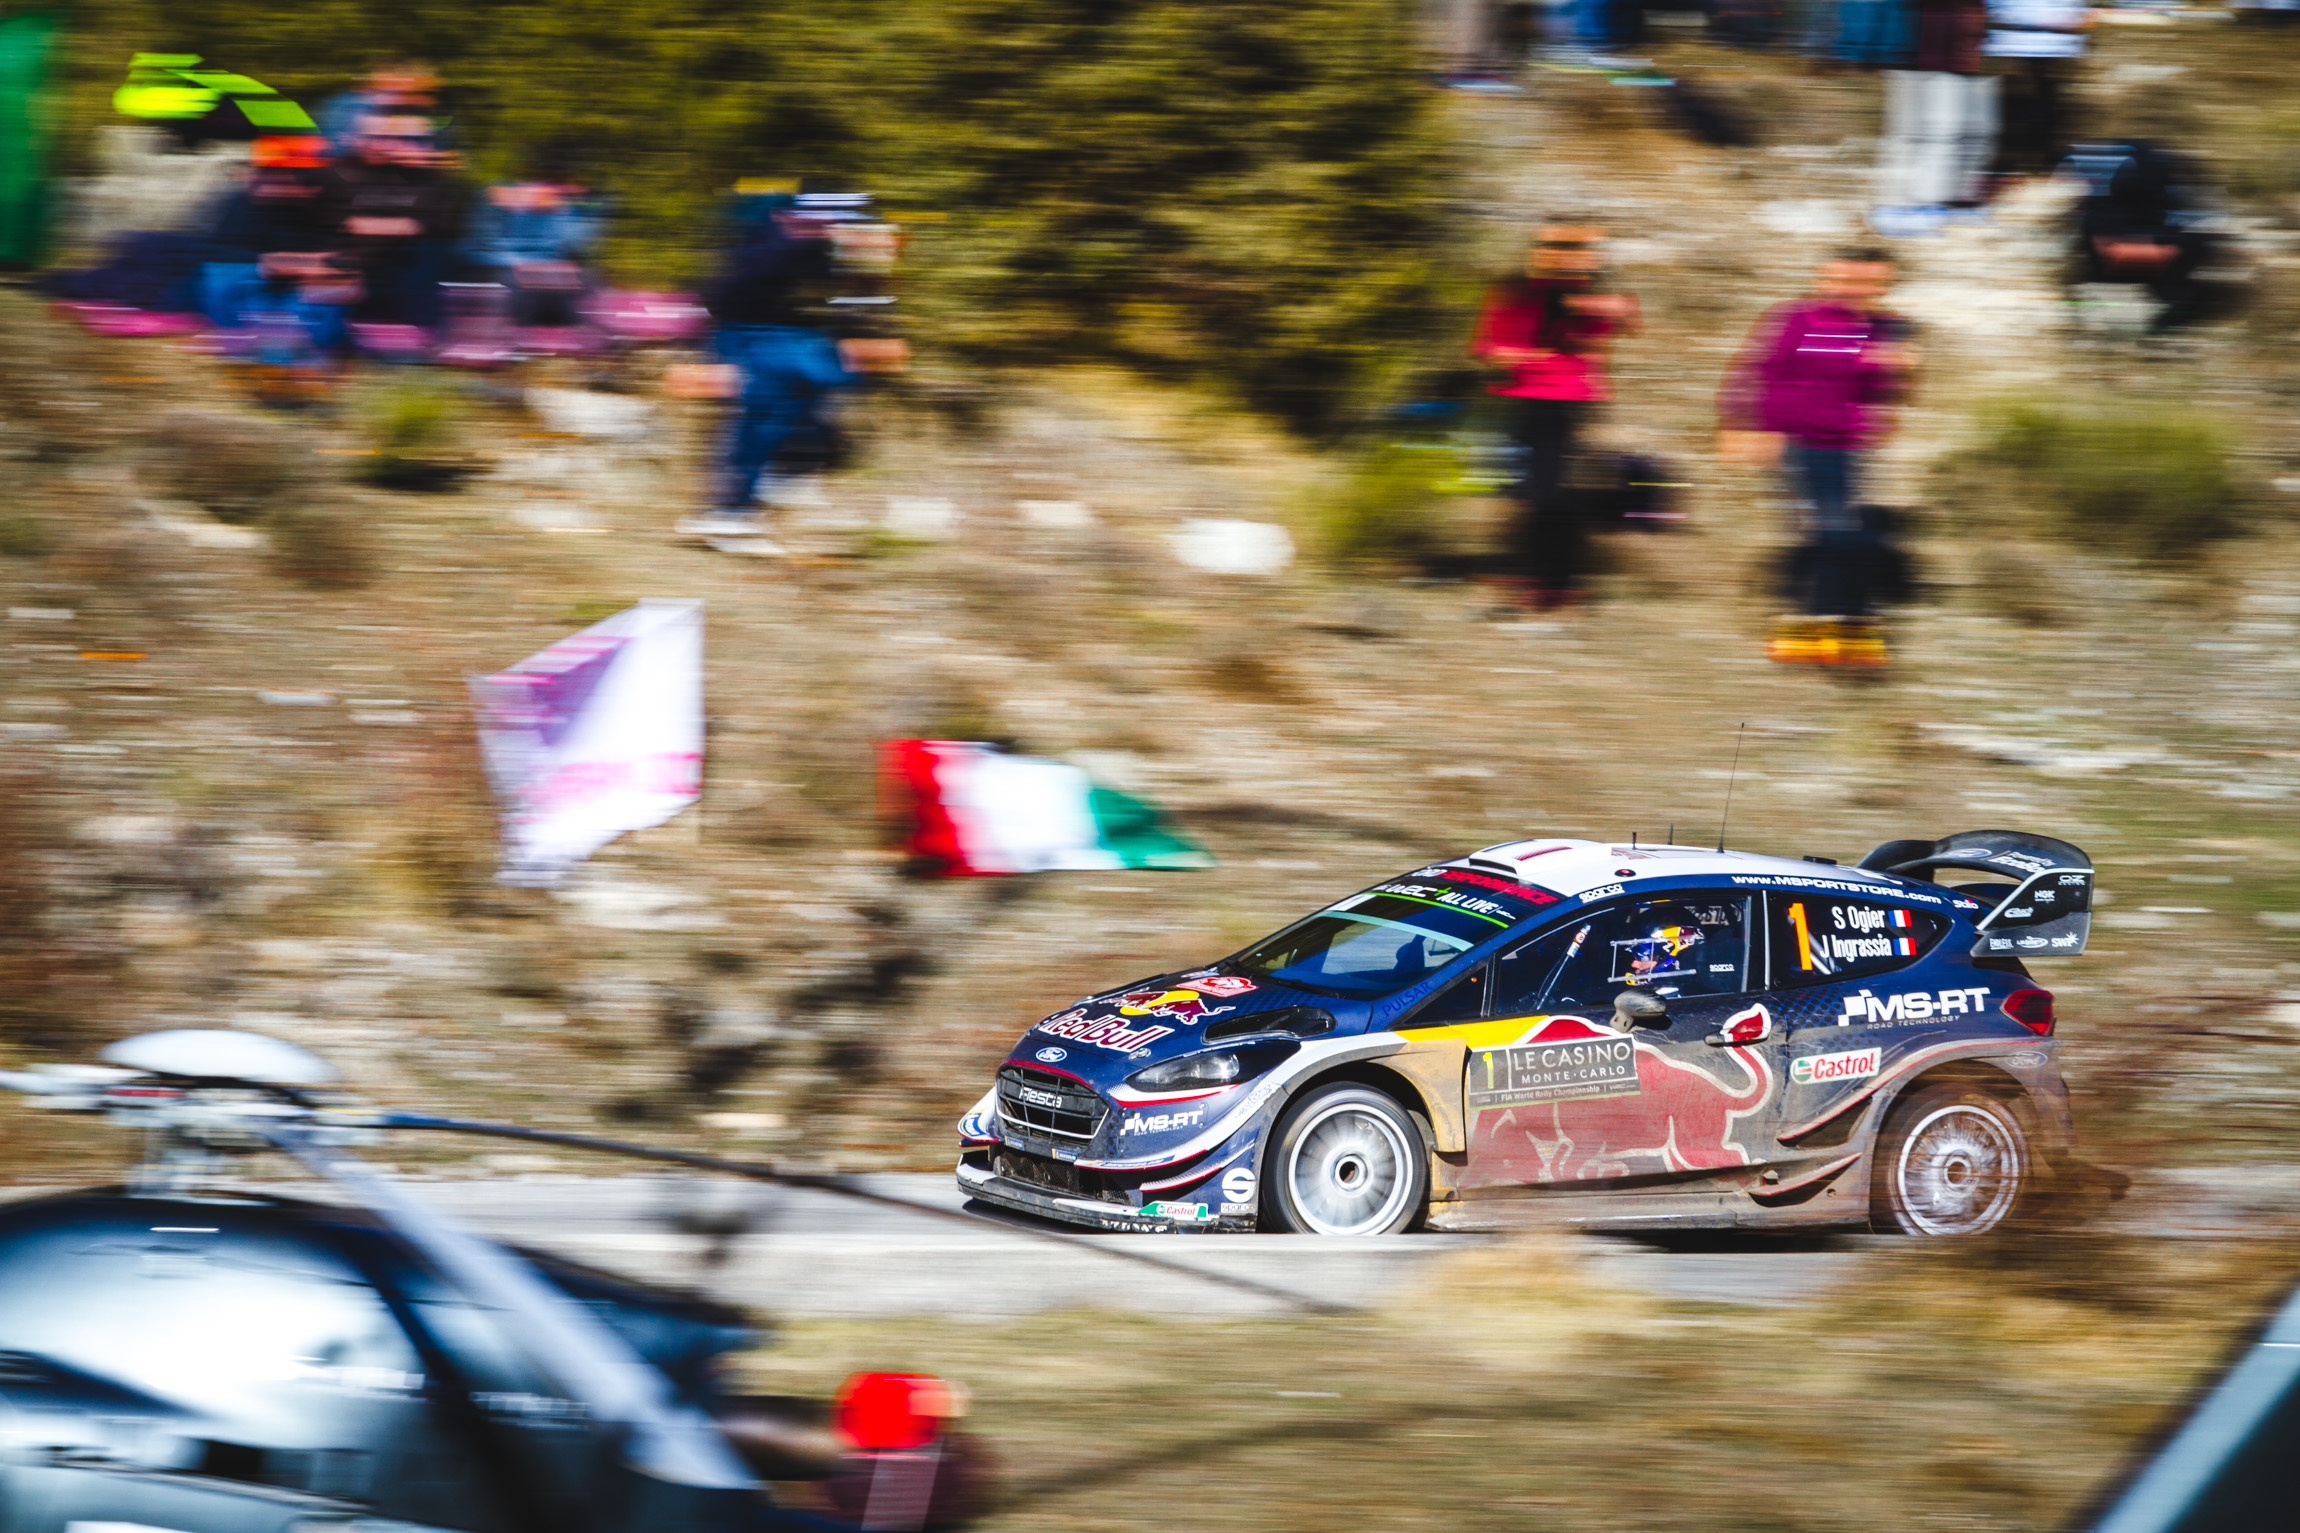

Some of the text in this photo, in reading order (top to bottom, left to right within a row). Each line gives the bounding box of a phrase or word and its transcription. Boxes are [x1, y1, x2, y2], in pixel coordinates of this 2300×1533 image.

[1436, 891, 1467, 905] ALL
[1461, 897, 1500, 914] LIVE
[1579, 884, 1625, 902] sparco
[1732, 876, 1942, 904] www.MSPORTSTORE.com
[1832, 905, 1885, 934] S Ogier
[1788, 903, 1813, 971] 1
[1820, 933, 1892, 963] J Ingrassia
[1381, 981, 1433, 1018] PULSAR
[1038, 1008, 1176, 1053] Red Bull
[1899, 1015, 1960, 1026] TECHNOLOGY
[1483, 1051, 1495, 1089] 1
[1514, 1042, 1631, 1071] LE CASINO
[1814, 1052, 1875, 1080] Castrol
[1521, 1065, 1626, 1084] MONTE CARLO
[1166, 1205, 1196, 1217] Castrol
